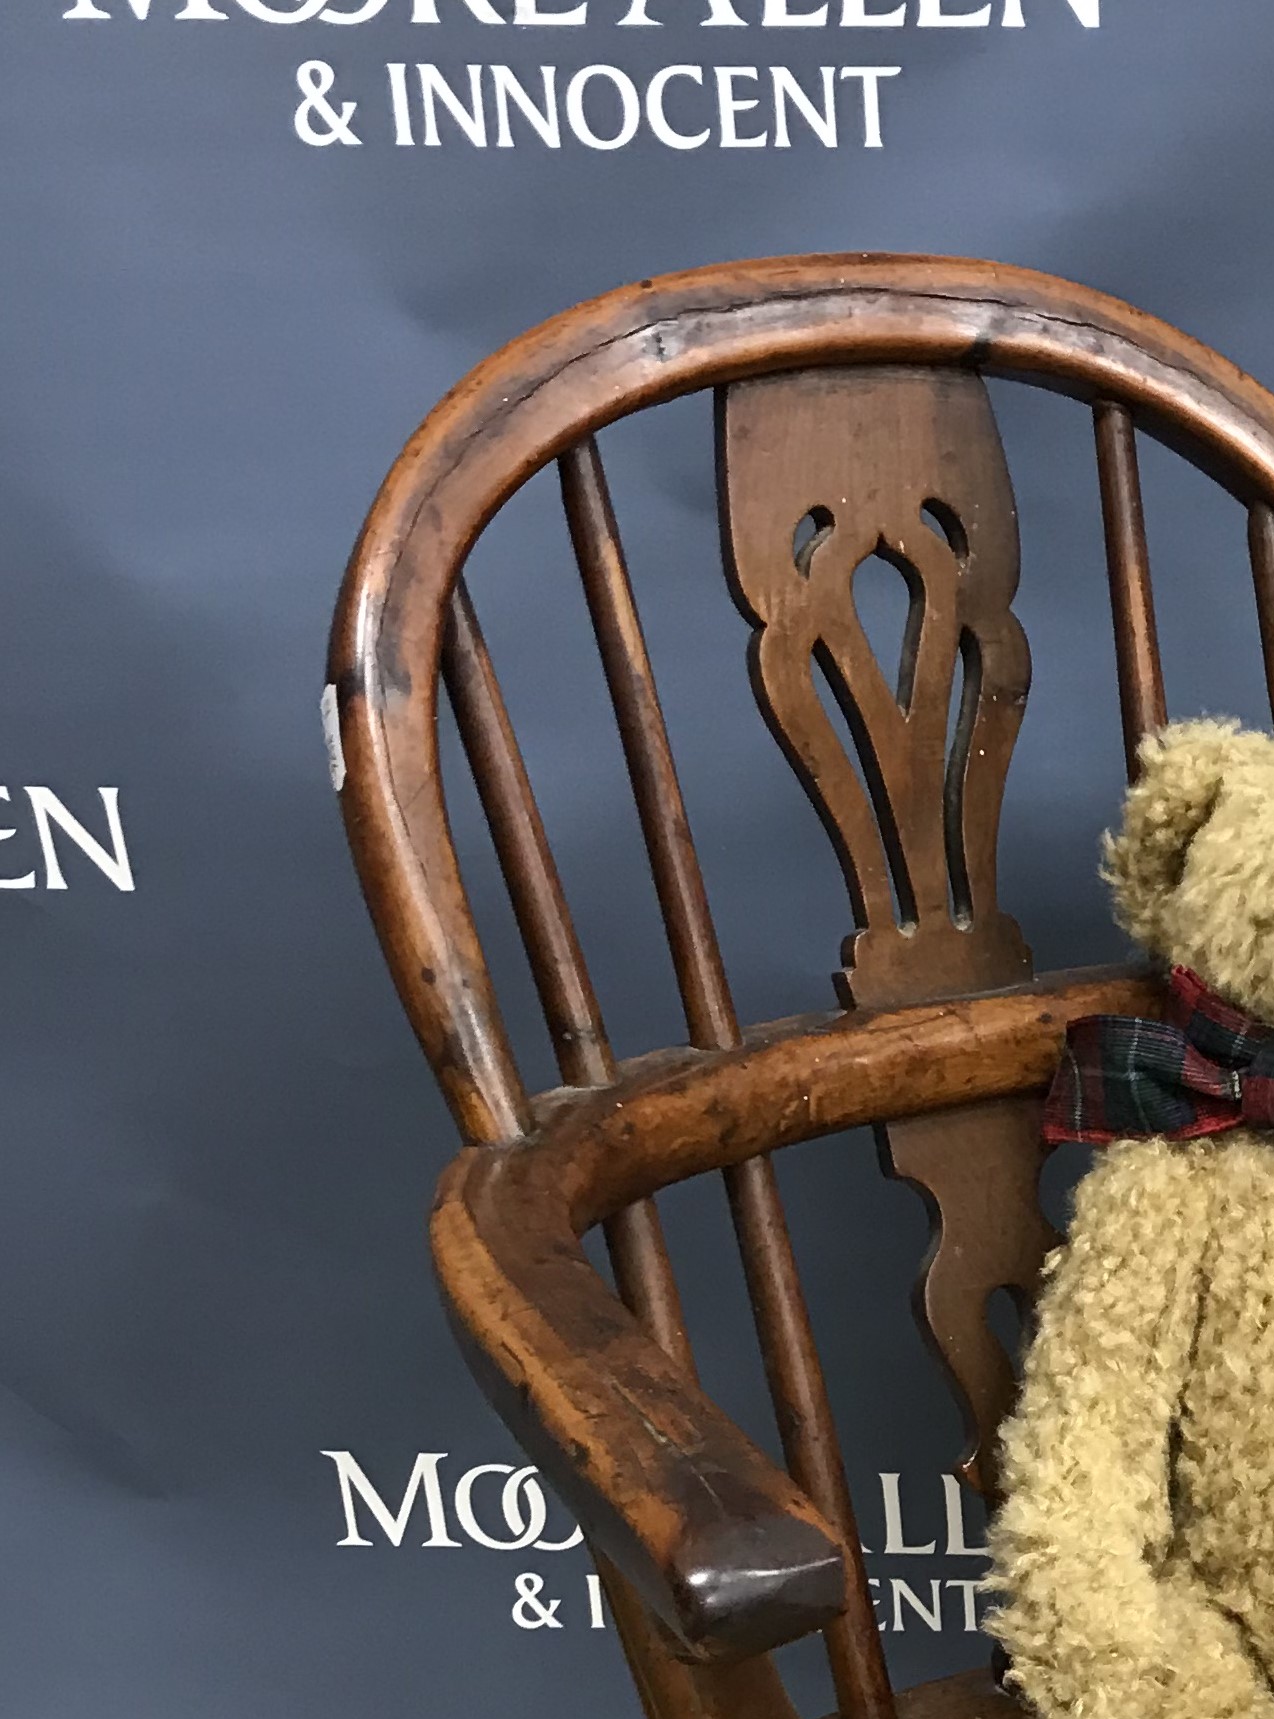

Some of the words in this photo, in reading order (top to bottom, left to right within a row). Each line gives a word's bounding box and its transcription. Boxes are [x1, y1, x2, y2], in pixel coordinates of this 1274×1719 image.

[293, 59, 363, 148] &
[386, 61, 903, 151] INNOCENT
[511, 1572, 564, 1630] &
